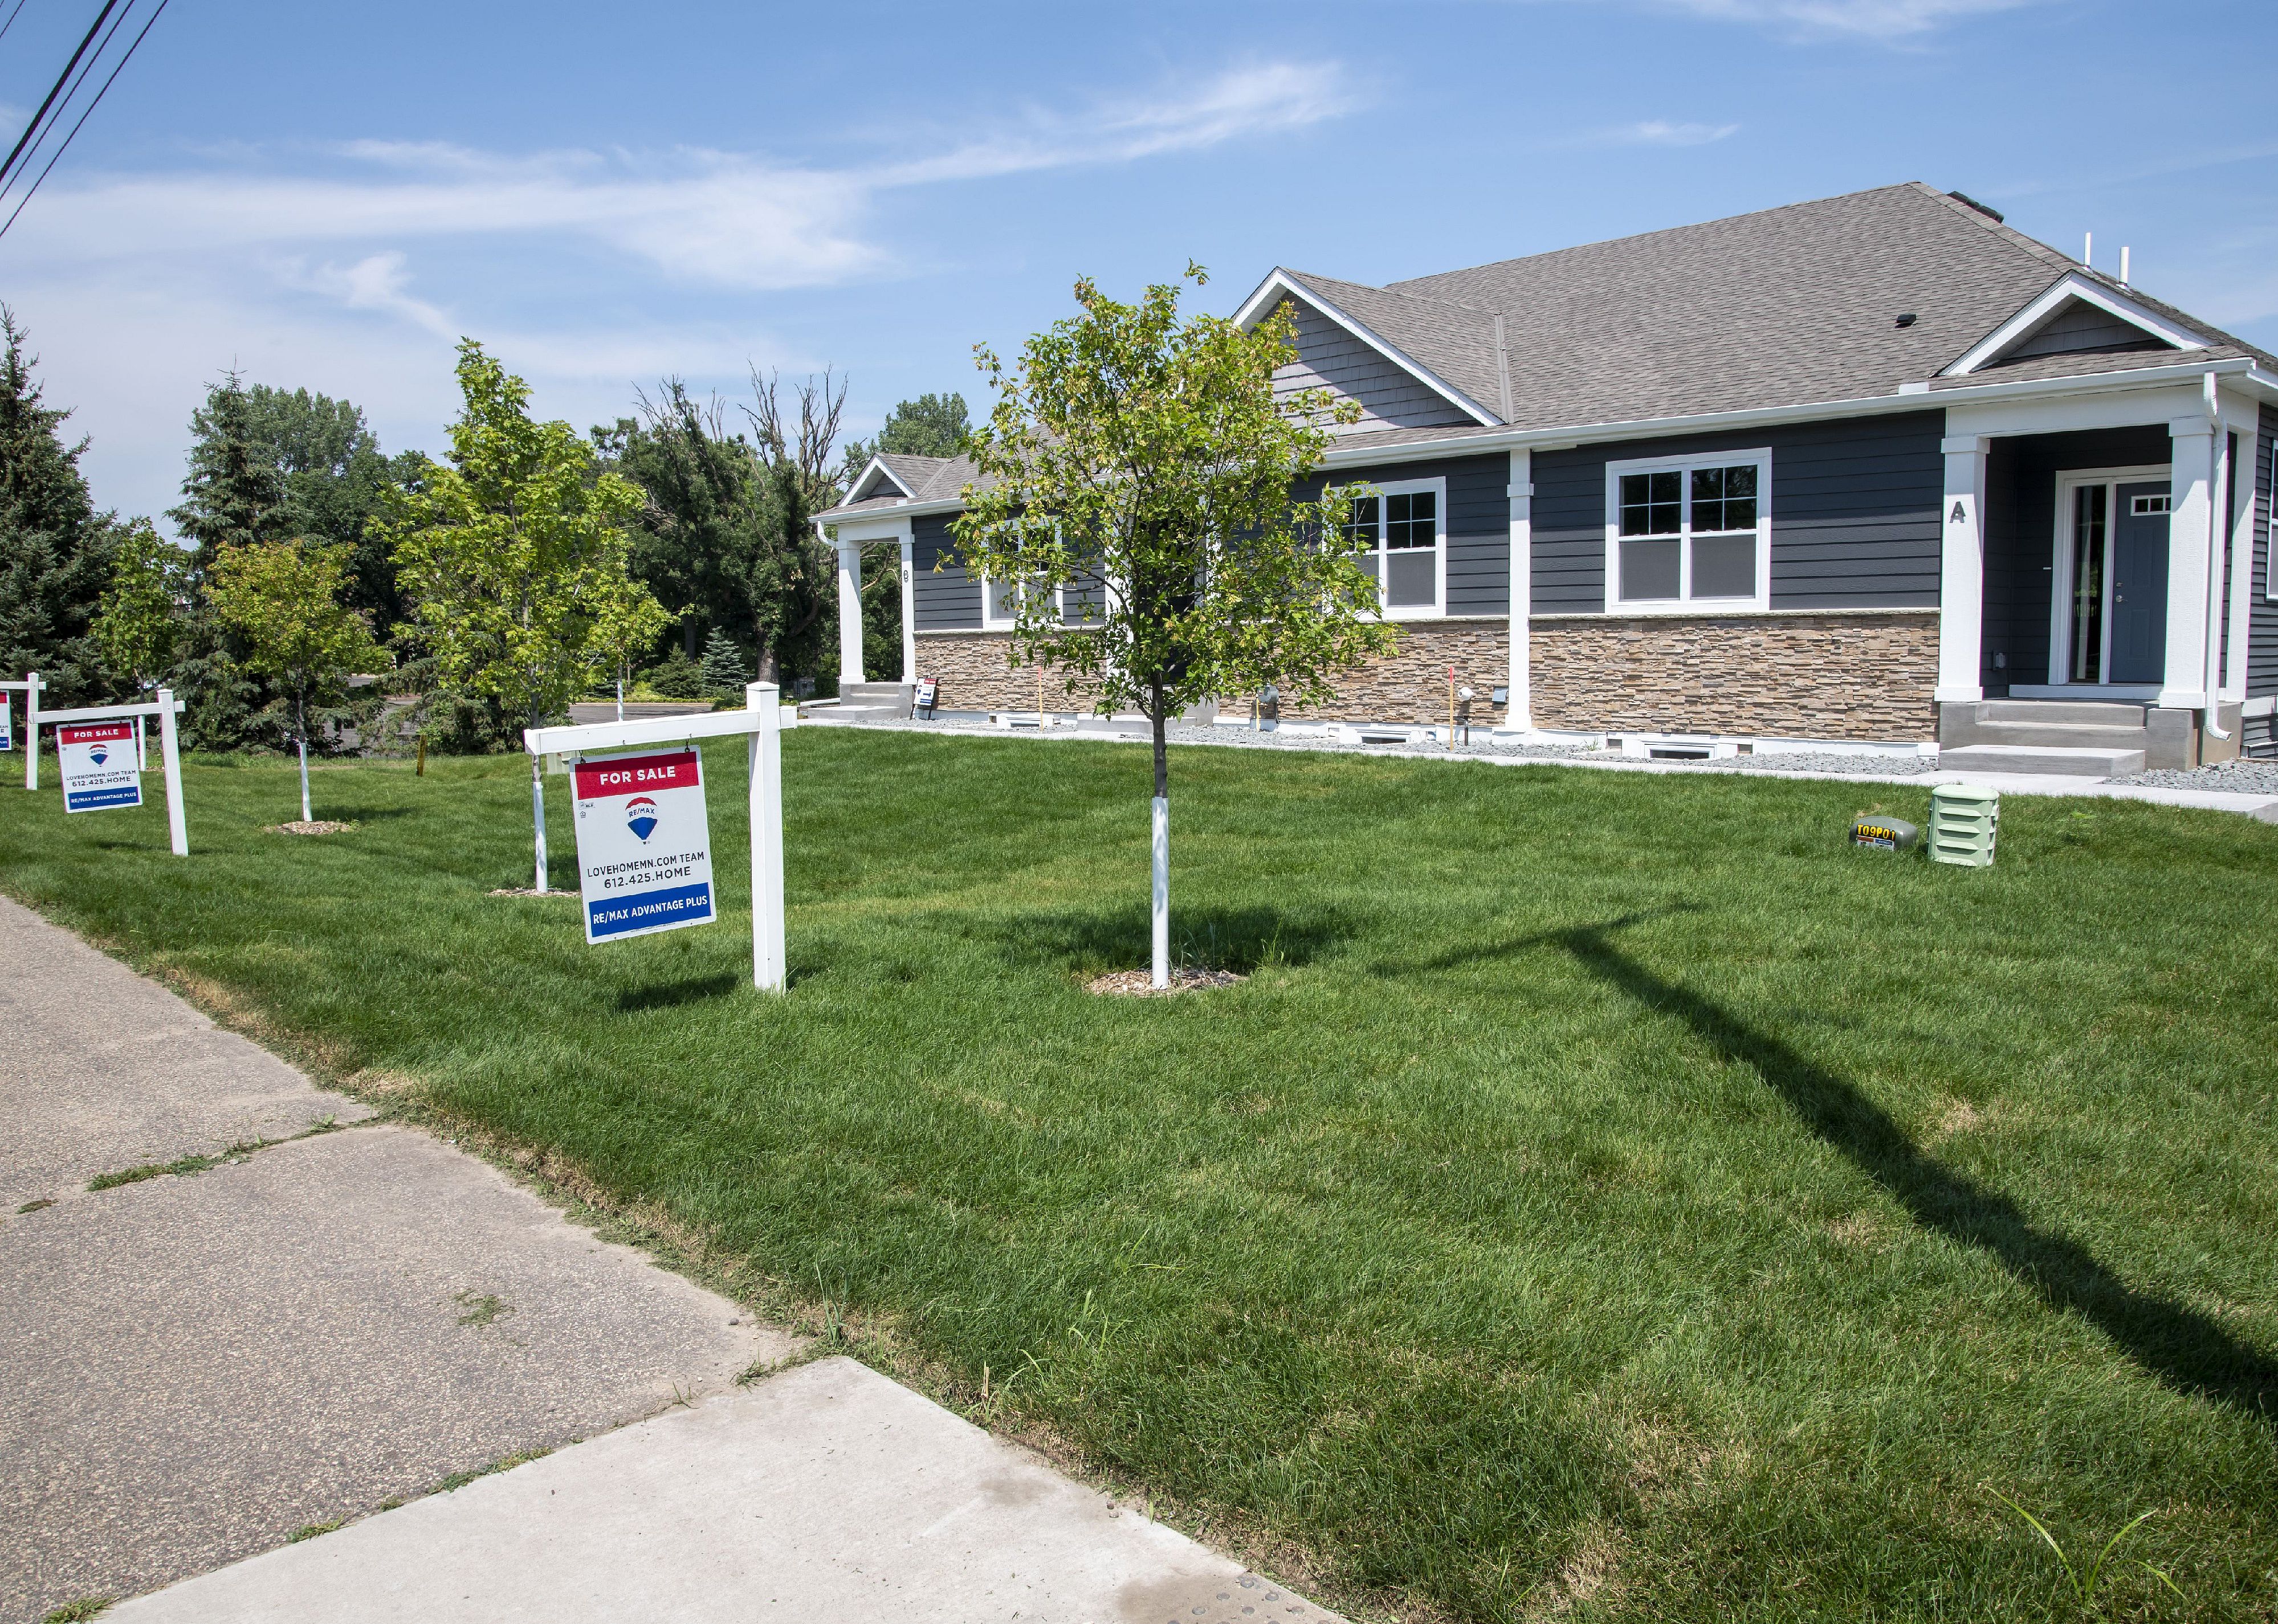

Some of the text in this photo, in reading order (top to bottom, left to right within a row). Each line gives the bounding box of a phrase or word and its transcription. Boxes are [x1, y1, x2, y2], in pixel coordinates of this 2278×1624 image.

[1950, 501, 1966, 519] A
[67, 771, 120, 781] LOVEHOMEMN.COM
[72, 776, 131, 787] 612.425.HOME
[600, 766, 676, 785] FOR SALE
[629, 807, 655, 818] RE/MAX
[587, 851, 704, 878] LOVEHOMEMN.COM TEAM
[604, 866, 691, 889] 612.425.HOME
[593, 895, 708, 925] RE/MAX ADVANTAGE PLUS
